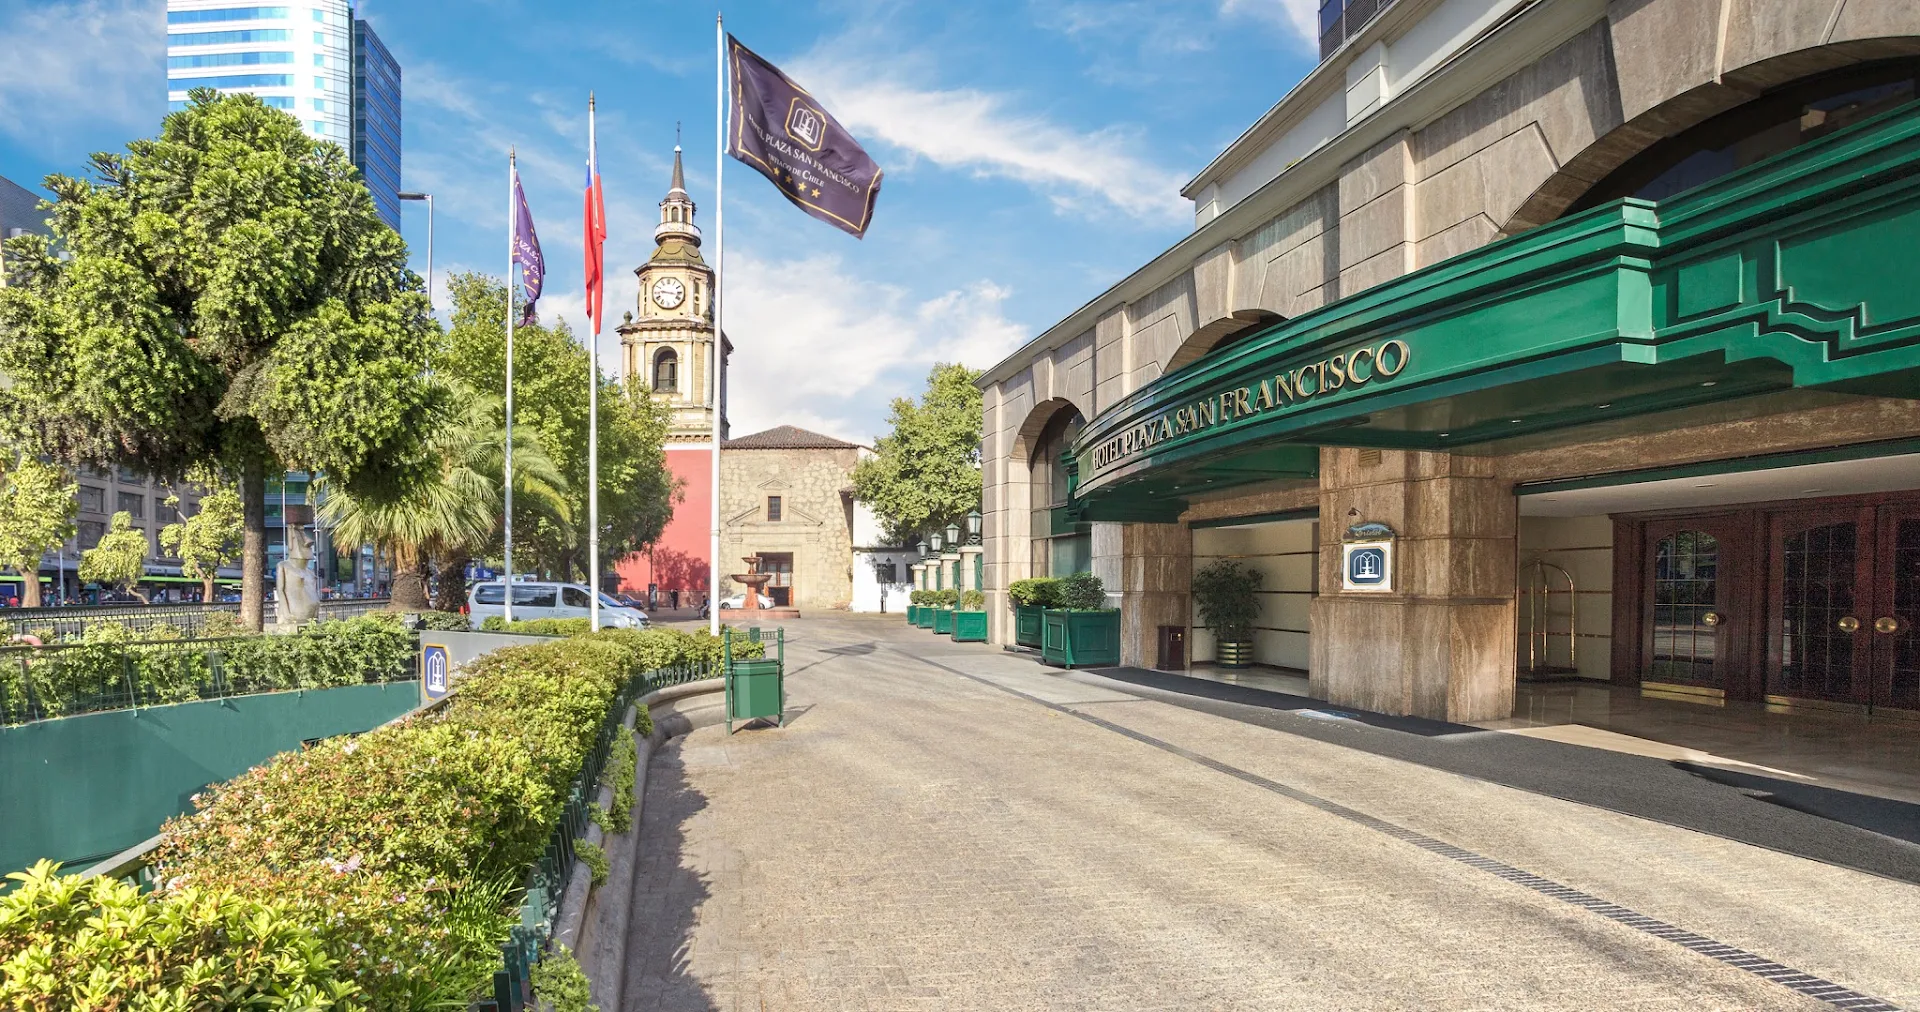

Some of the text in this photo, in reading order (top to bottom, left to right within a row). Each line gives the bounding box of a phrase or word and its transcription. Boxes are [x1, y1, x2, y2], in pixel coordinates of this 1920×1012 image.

[765, 133, 792, 156] PLAZA
[793, 148, 812, 165] SAN
[813, 160, 860, 193] FRANCISCO
[1092, 340, 1411, 470] HOTEL PLAZA SAN FRANCISCO
